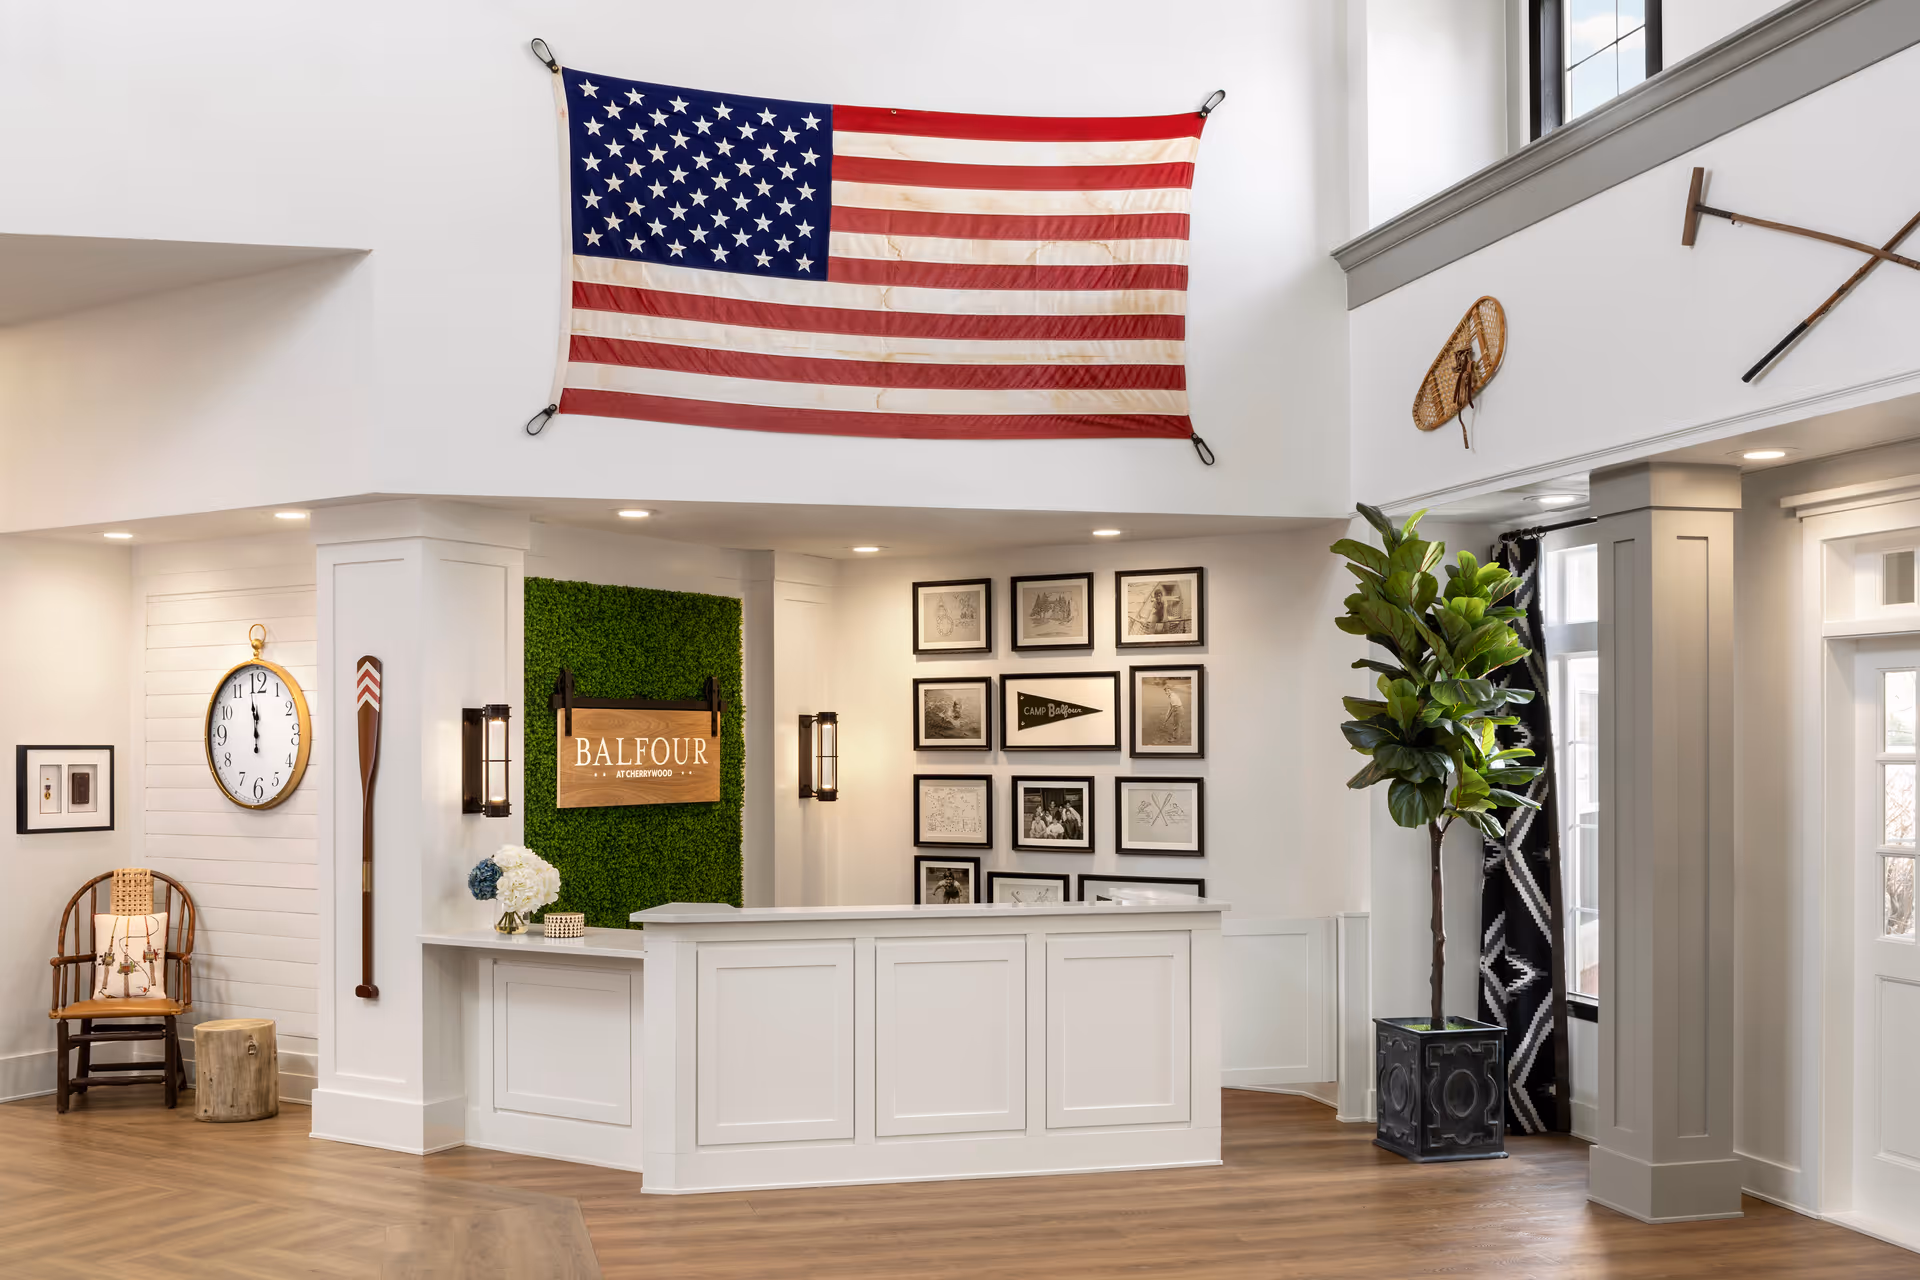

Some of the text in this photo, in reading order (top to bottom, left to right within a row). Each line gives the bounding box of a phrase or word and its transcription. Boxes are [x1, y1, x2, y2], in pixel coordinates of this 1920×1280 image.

[249, 671, 267, 694] 12
[275, 682, 280, 698] 1
[233, 683, 243, 699] 11
[221, 705, 233, 720] 10
[285, 701, 293, 716] 2
[1024, 703, 1082, 718] CAMP Balfour
[216, 724, 228, 746] 9
[291, 723, 300, 746] 3
[224, 752, 232, 767] 8
[574, 737, 708, 766] BALFOUR
[285, 752, 293, 768] 4
[238, 771, 246, 786] 7
[271, 771, 280, 787] 5
[616, 769, 672, 778] AT CHERRYWOOD
[253, 777, 264, 799] 6
